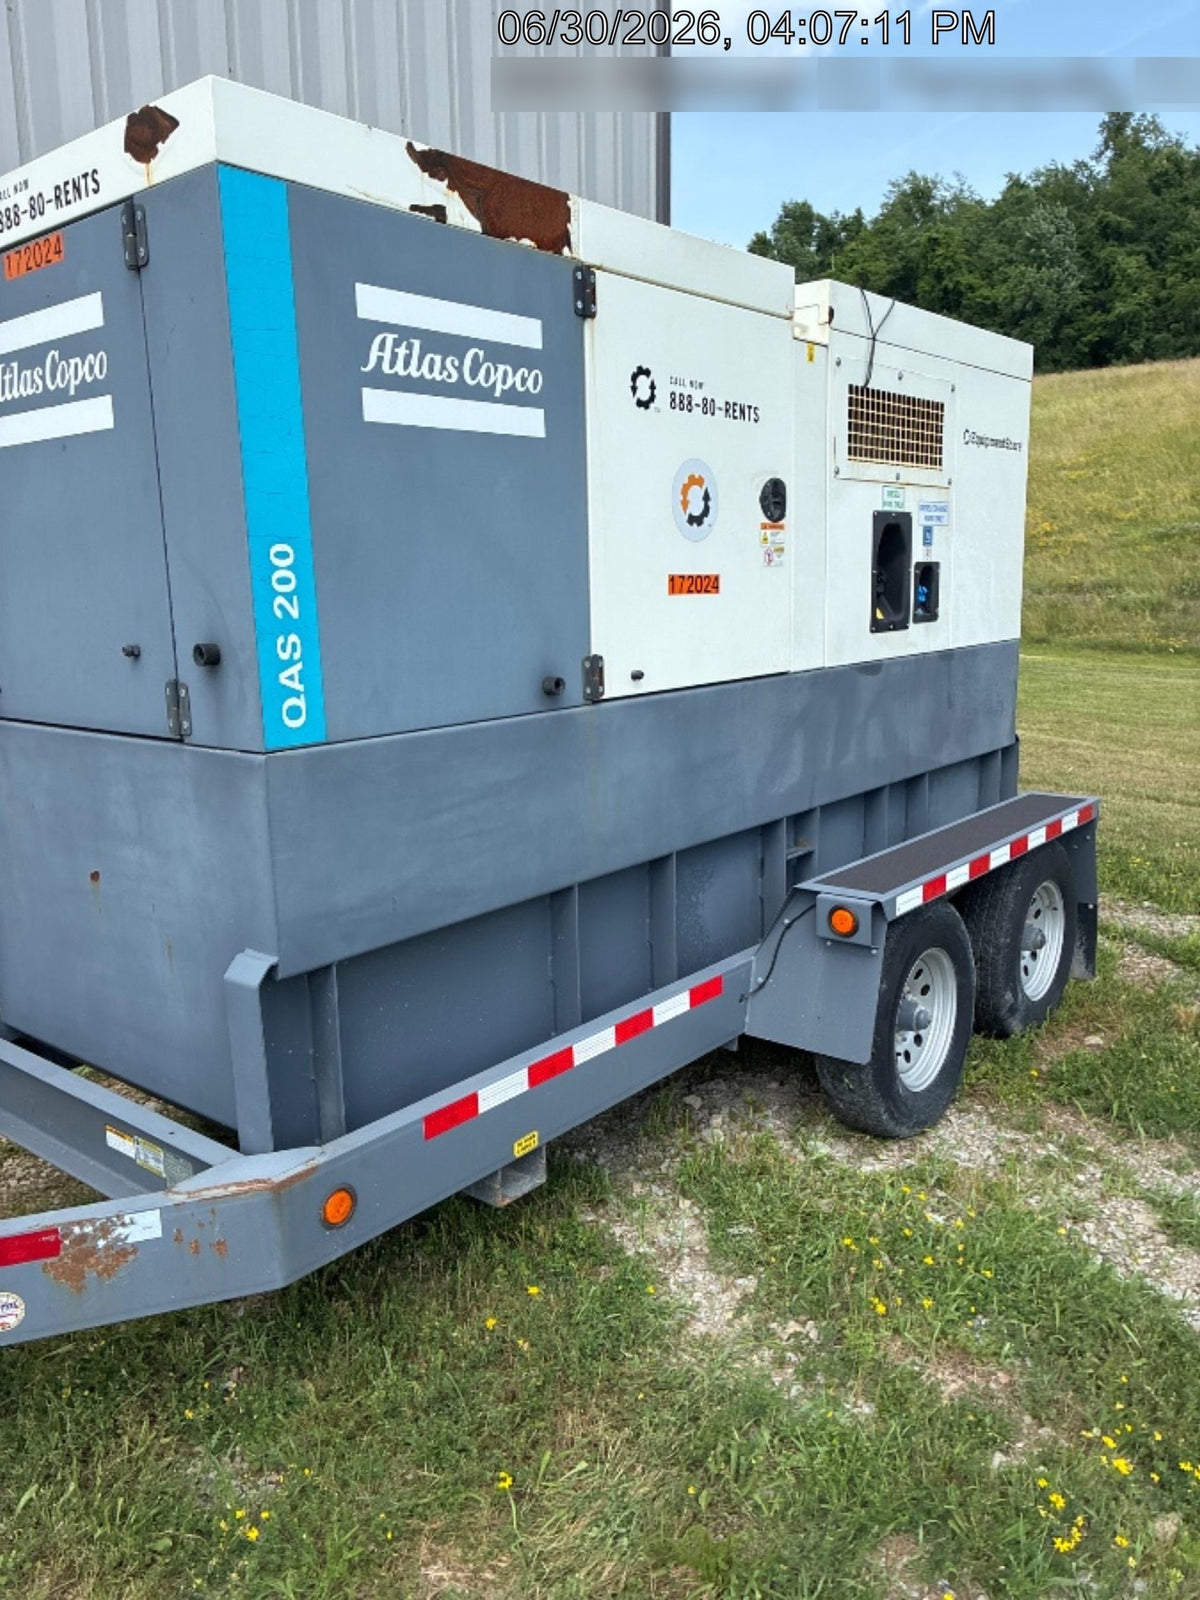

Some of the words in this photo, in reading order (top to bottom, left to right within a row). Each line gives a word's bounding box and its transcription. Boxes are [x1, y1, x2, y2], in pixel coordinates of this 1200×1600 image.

[6, 234, 62, 277] 172024
[0, 361, 43, 402] tlas
[45, 349, 108, 396] Copco
[360, 332, 459, 383] Atlas
[463, 348, 542, 397] Copco
[669, 391, 760, 423] 888-80-RENTS
[269, 543, 300, 619] 200
[669, 575, 719, 594] 172024
[276, 632, 307, 729] QAS
